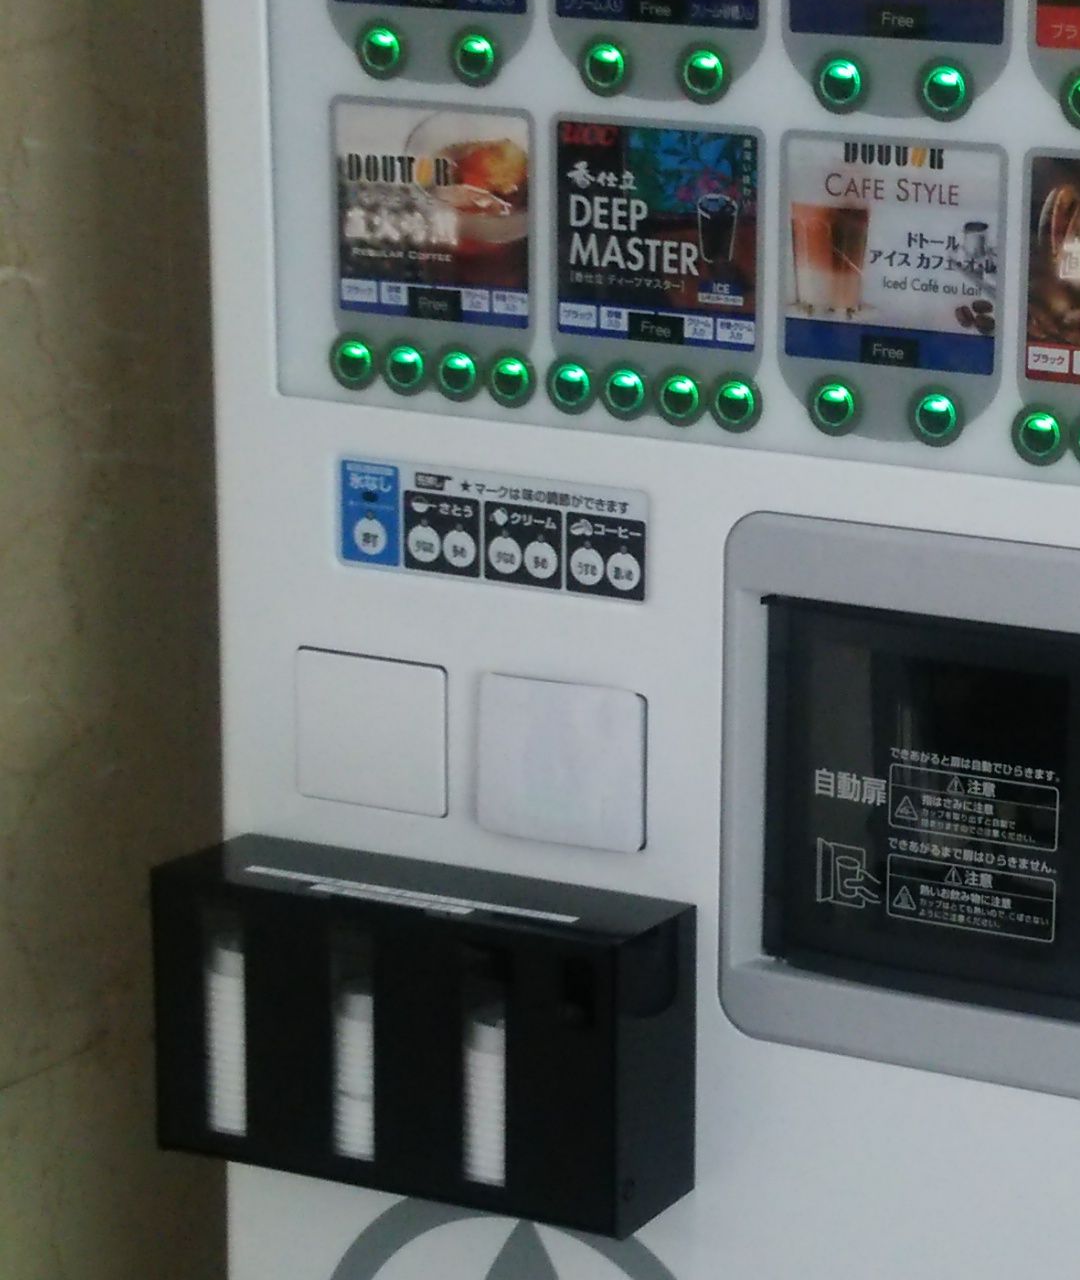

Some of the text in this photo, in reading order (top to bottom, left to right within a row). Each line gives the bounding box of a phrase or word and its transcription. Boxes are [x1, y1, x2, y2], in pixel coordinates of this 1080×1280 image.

[640, 0, 672, 17] Free
[881, 11, 915, 28] Free
[348, 153, 449, 187] DOUTOR
[825, 173, 960, 206] CAFE STYLE
[569, 194, 648, 231] DEEP
[907, 232, 960, 251] ドトール
[569, 232, 699, 276] MASTER
[870, 250, 911, 267] アイス
[712, 283, 730, 294] ICE
[883, 277, 982, 297] Iced Café au Lait
[640, 321, 672, 338] Free
[872, 344, 905, 360] Free
[1032, 353, 1065, 365] ブラック
[439, 503, 473, 518] さとう
[510, 513, 557, 530] クリーム
[594, 523, 643, 540] コーヒー
[815, 768, 887, 807] 自動扉
[967, 780, 997, 798] 注意
[965, 870, 993, 888] 注意
